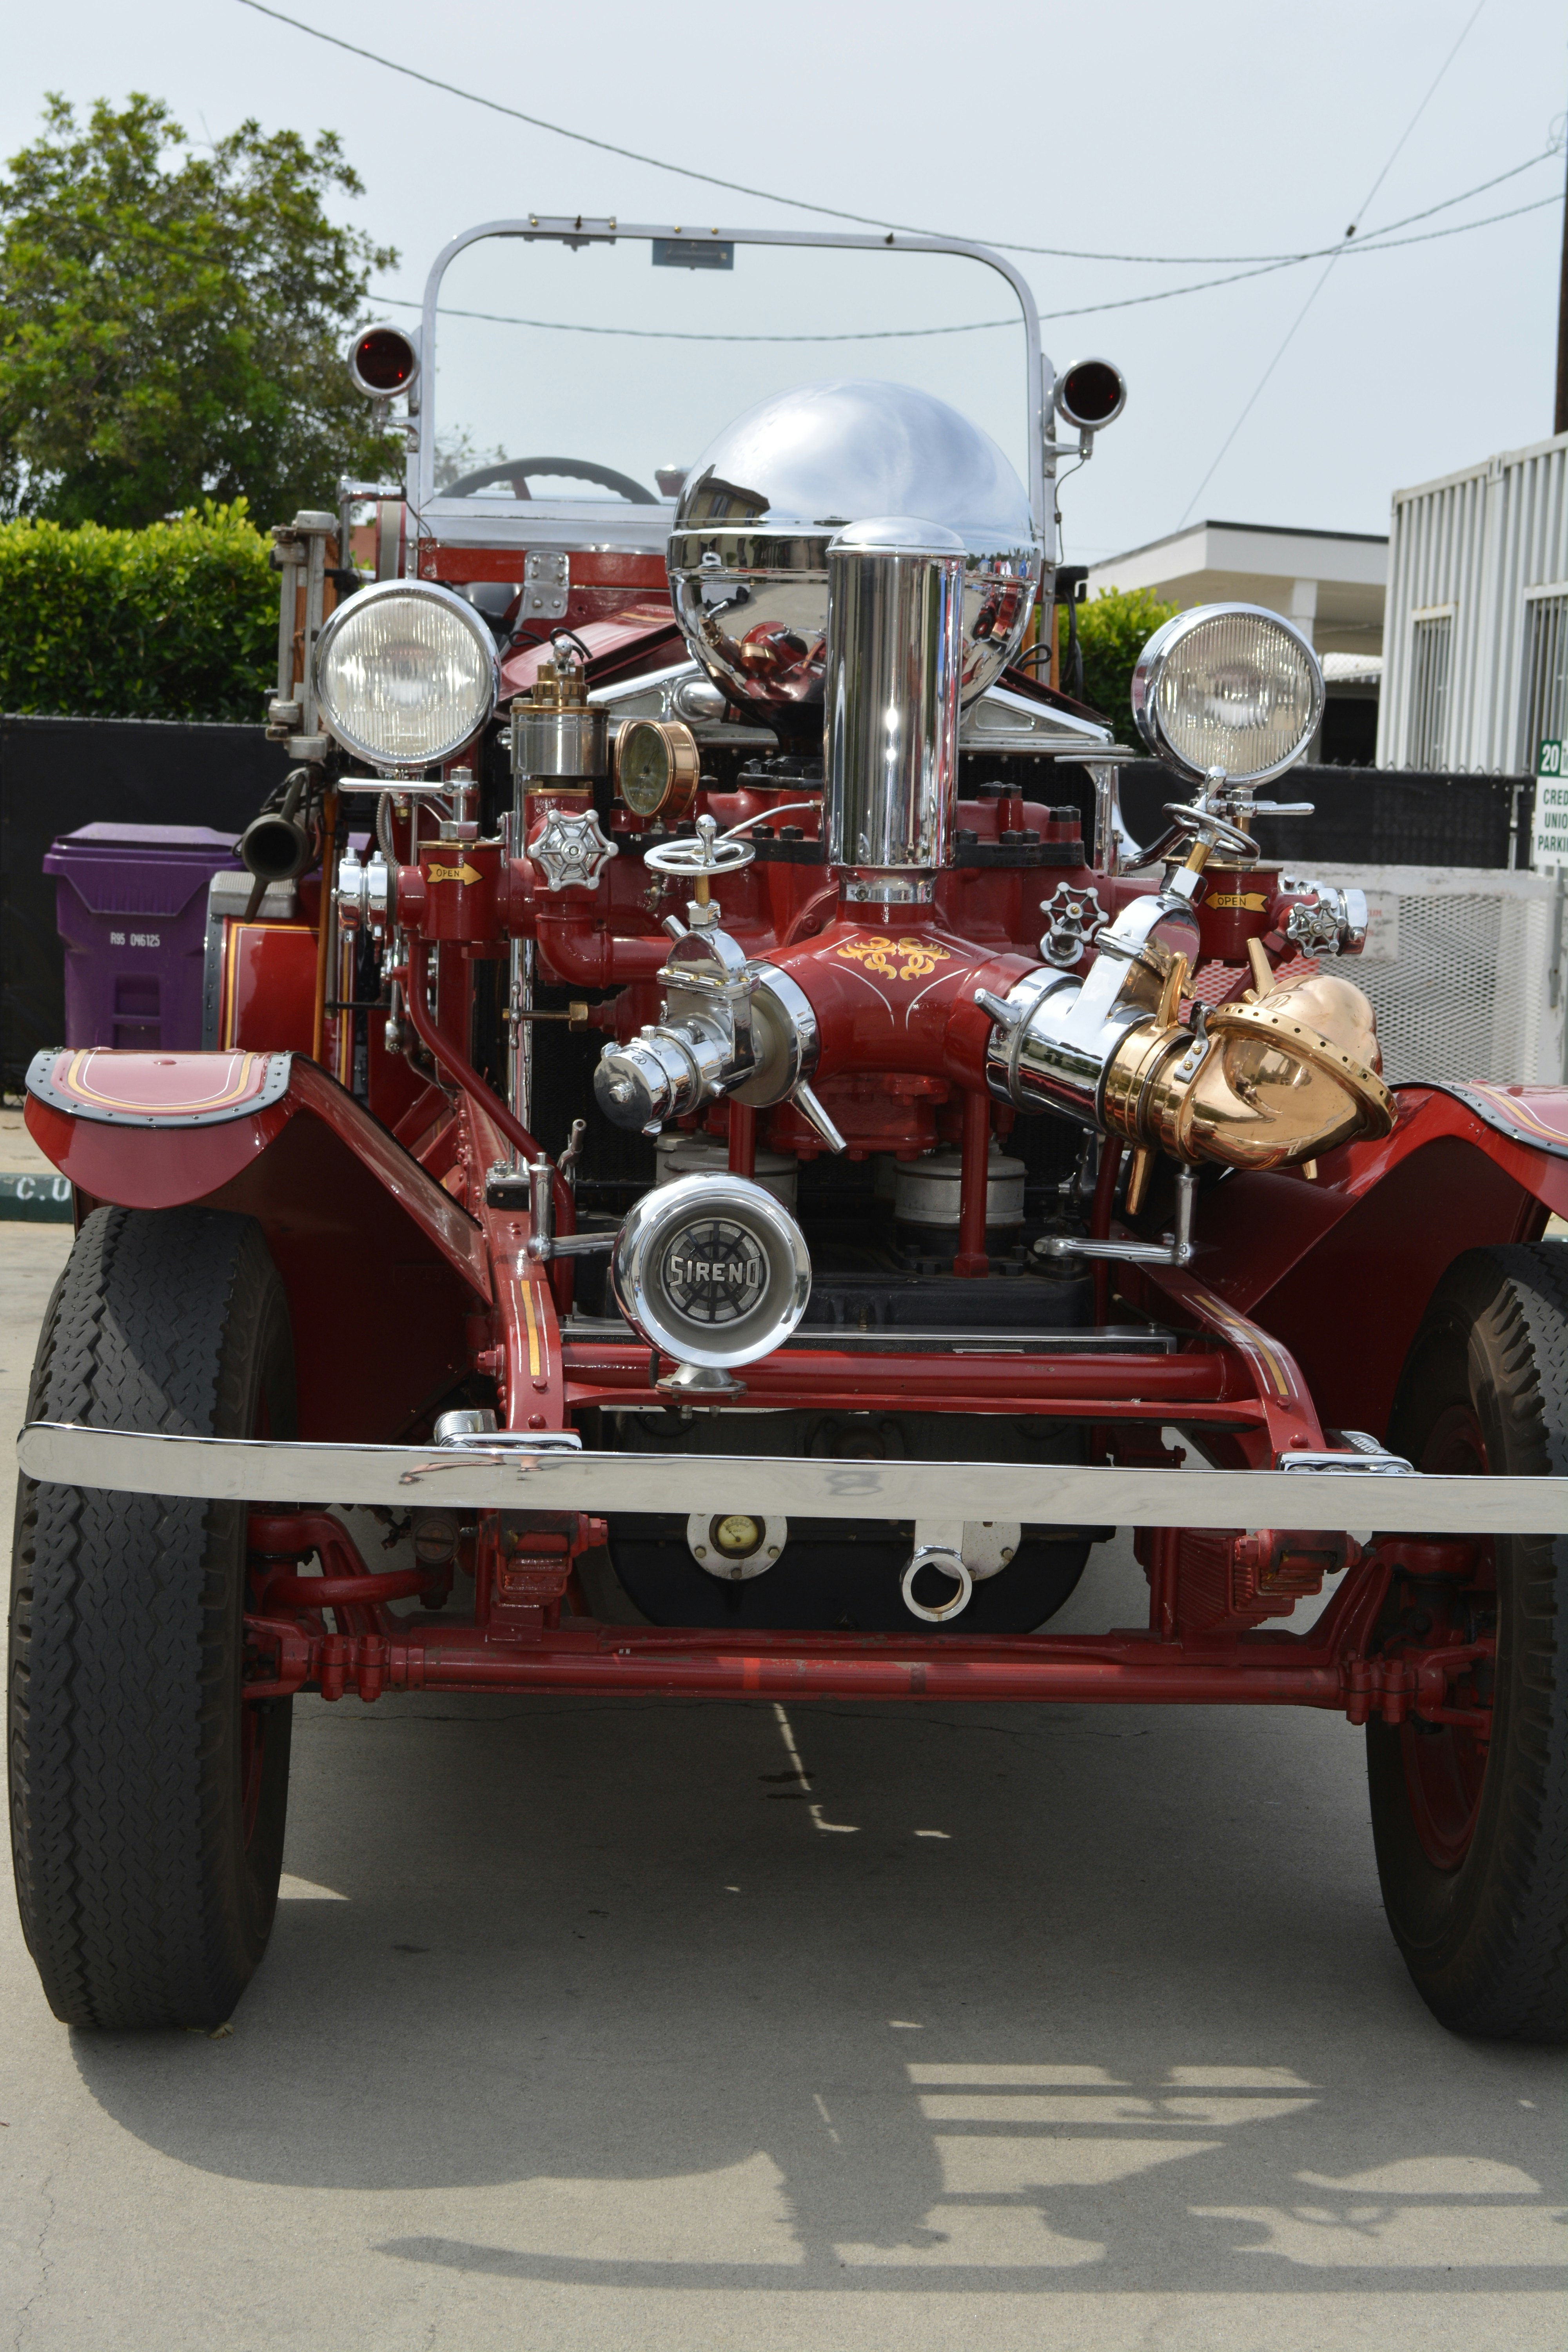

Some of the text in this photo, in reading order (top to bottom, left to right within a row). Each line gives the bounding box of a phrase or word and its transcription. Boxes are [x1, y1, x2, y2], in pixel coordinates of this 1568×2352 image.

[1541, 744, 1560, 772] 20
[1538, 835, 1568, 852] PARKI
[436, 869, 459, 877] OPEN
[1218, 897, 1246, 906] OPEN
[110, 932, 160, 947] R95 046125
[670, 1254, 760, 1289] SIRENO
